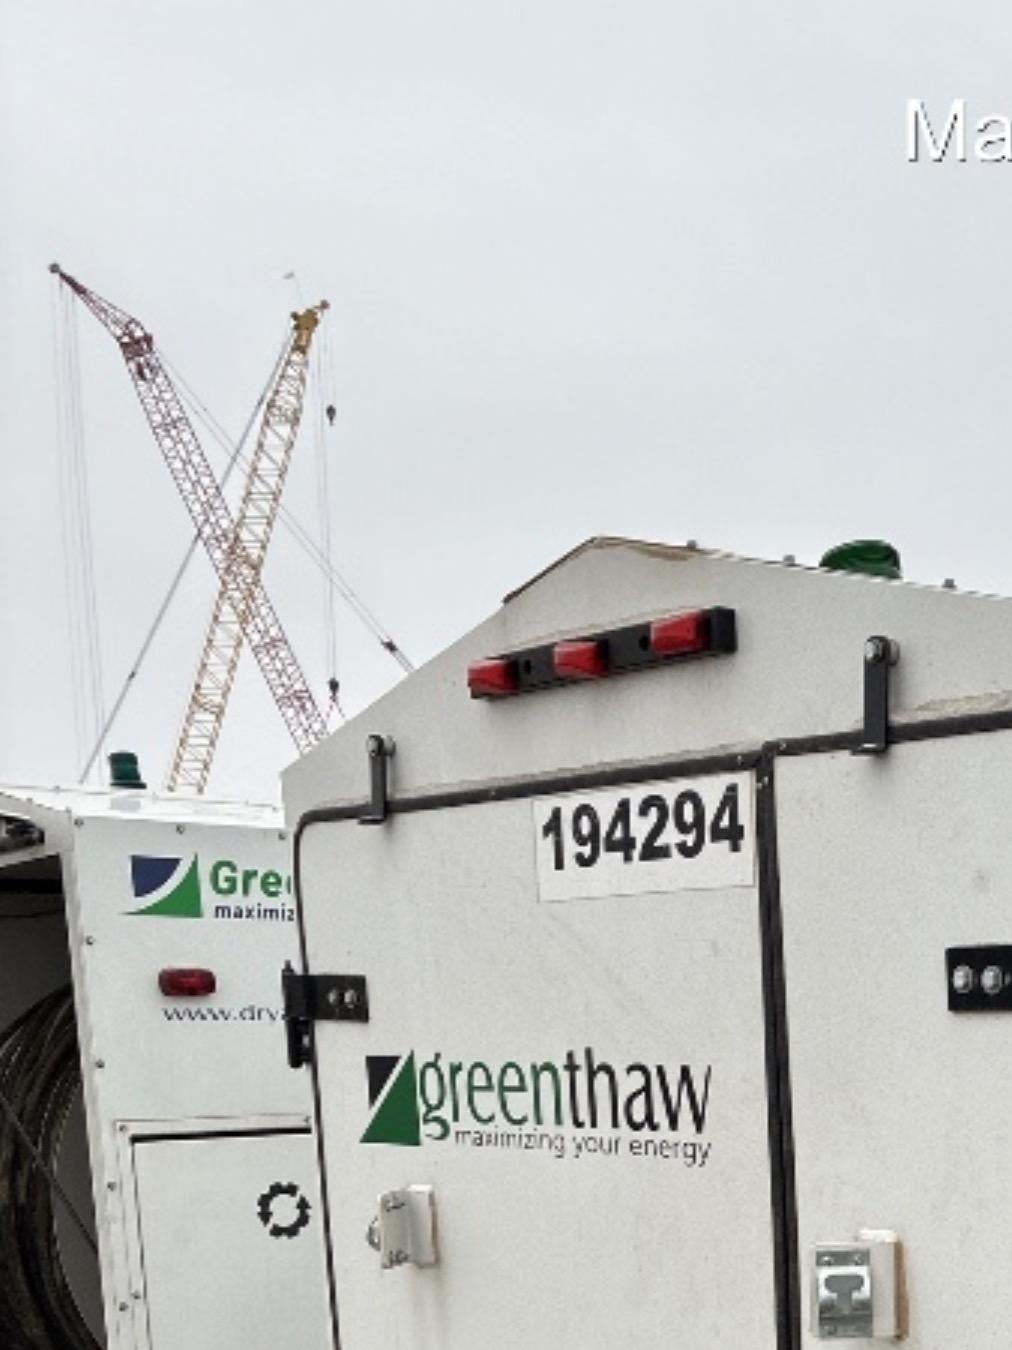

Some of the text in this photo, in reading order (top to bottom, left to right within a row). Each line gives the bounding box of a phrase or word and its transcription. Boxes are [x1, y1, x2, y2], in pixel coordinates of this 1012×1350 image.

[542, 782, 745, 871] 194294
[210, 860, 291, 897] Gre
[419, 1046, 712, 1141] greenthaw
[455, 1125, 712, 1168] maximizing your energy
